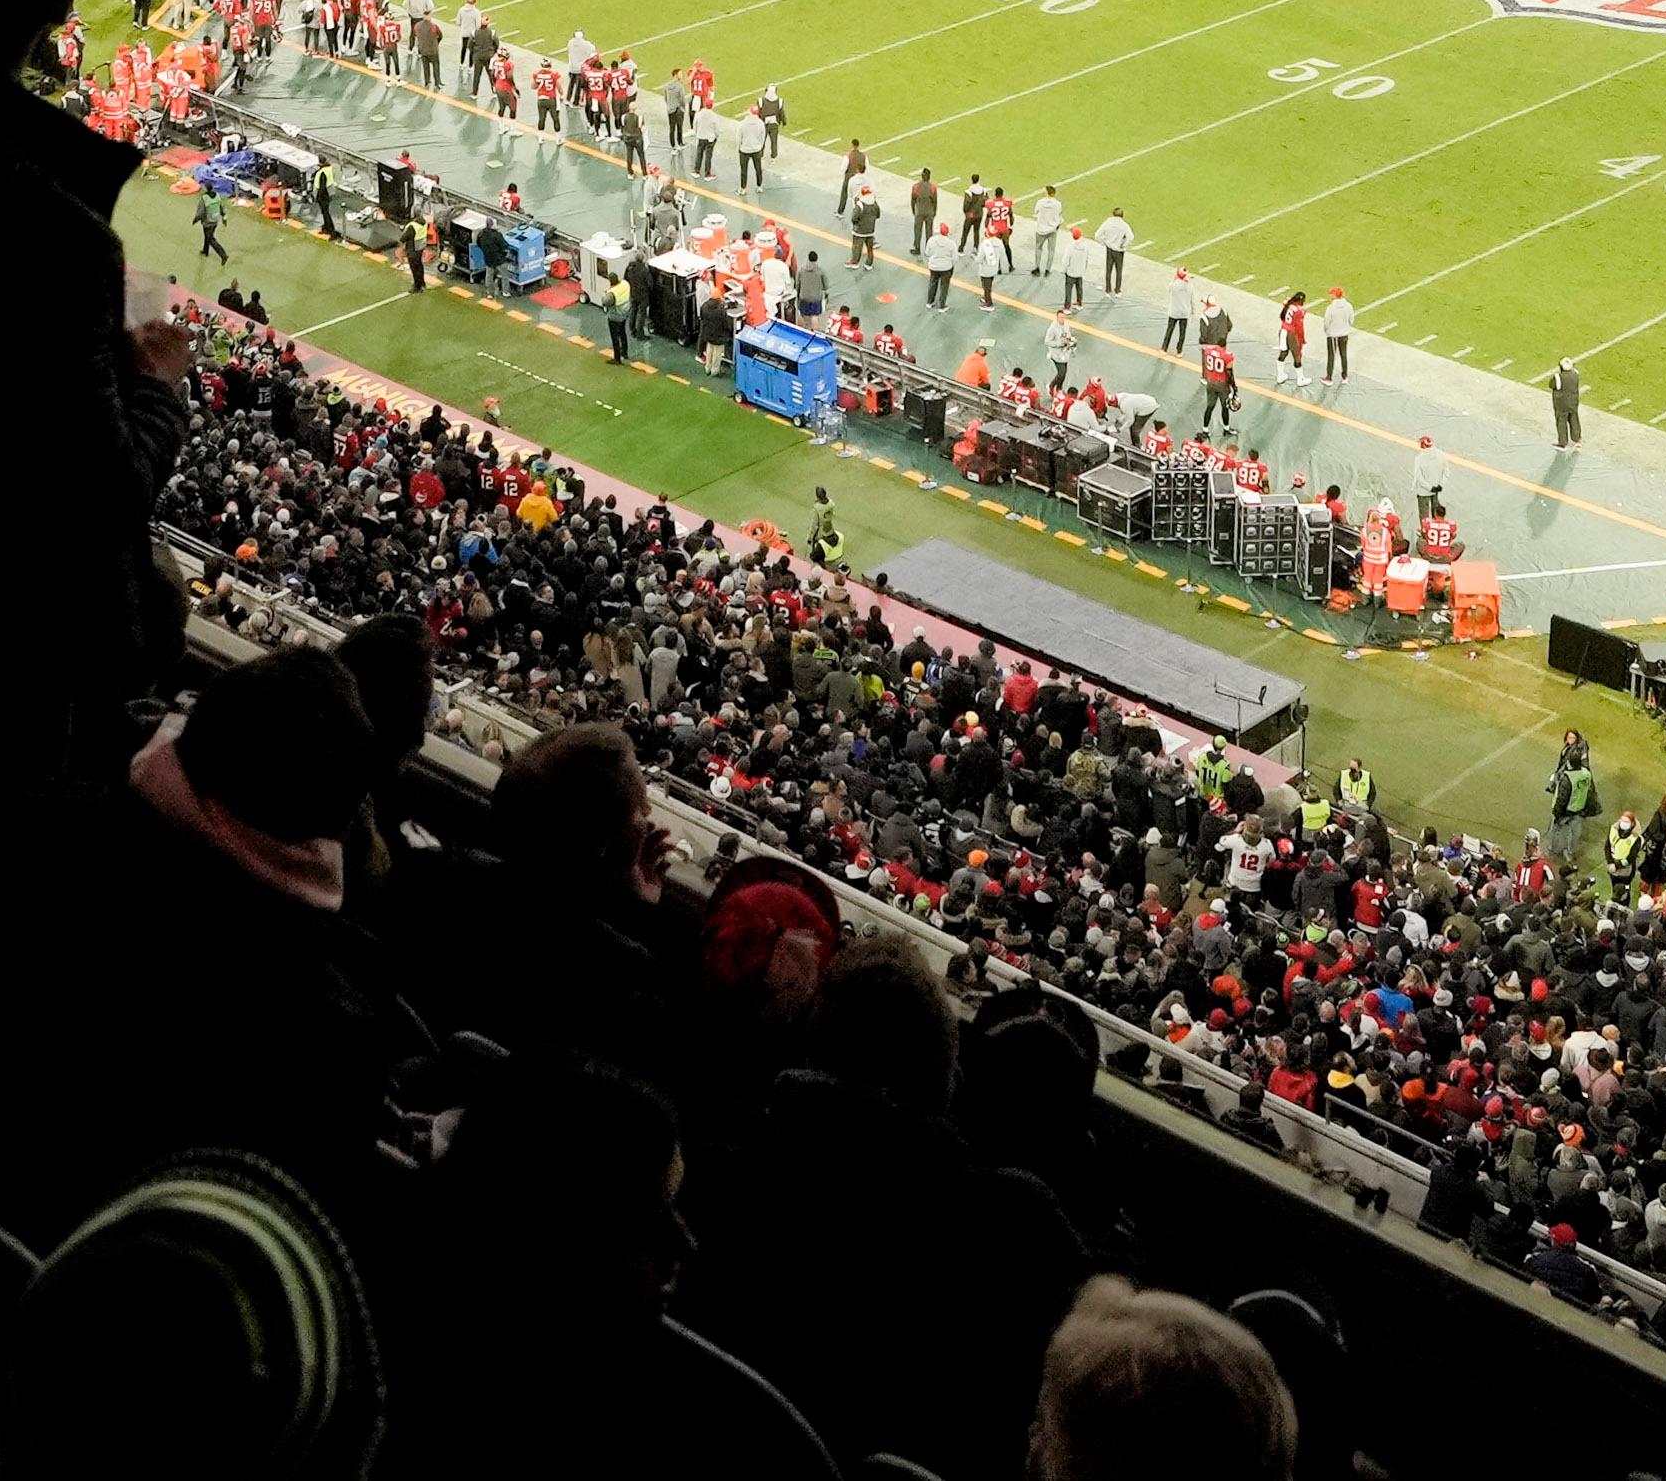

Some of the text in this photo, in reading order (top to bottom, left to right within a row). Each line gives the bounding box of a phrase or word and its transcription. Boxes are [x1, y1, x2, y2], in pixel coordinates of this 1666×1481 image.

[1266, 57, 1397, 100] 50
[1206, 355, 1224, 374] 90
[1428, 530, 1451, 548] 92
